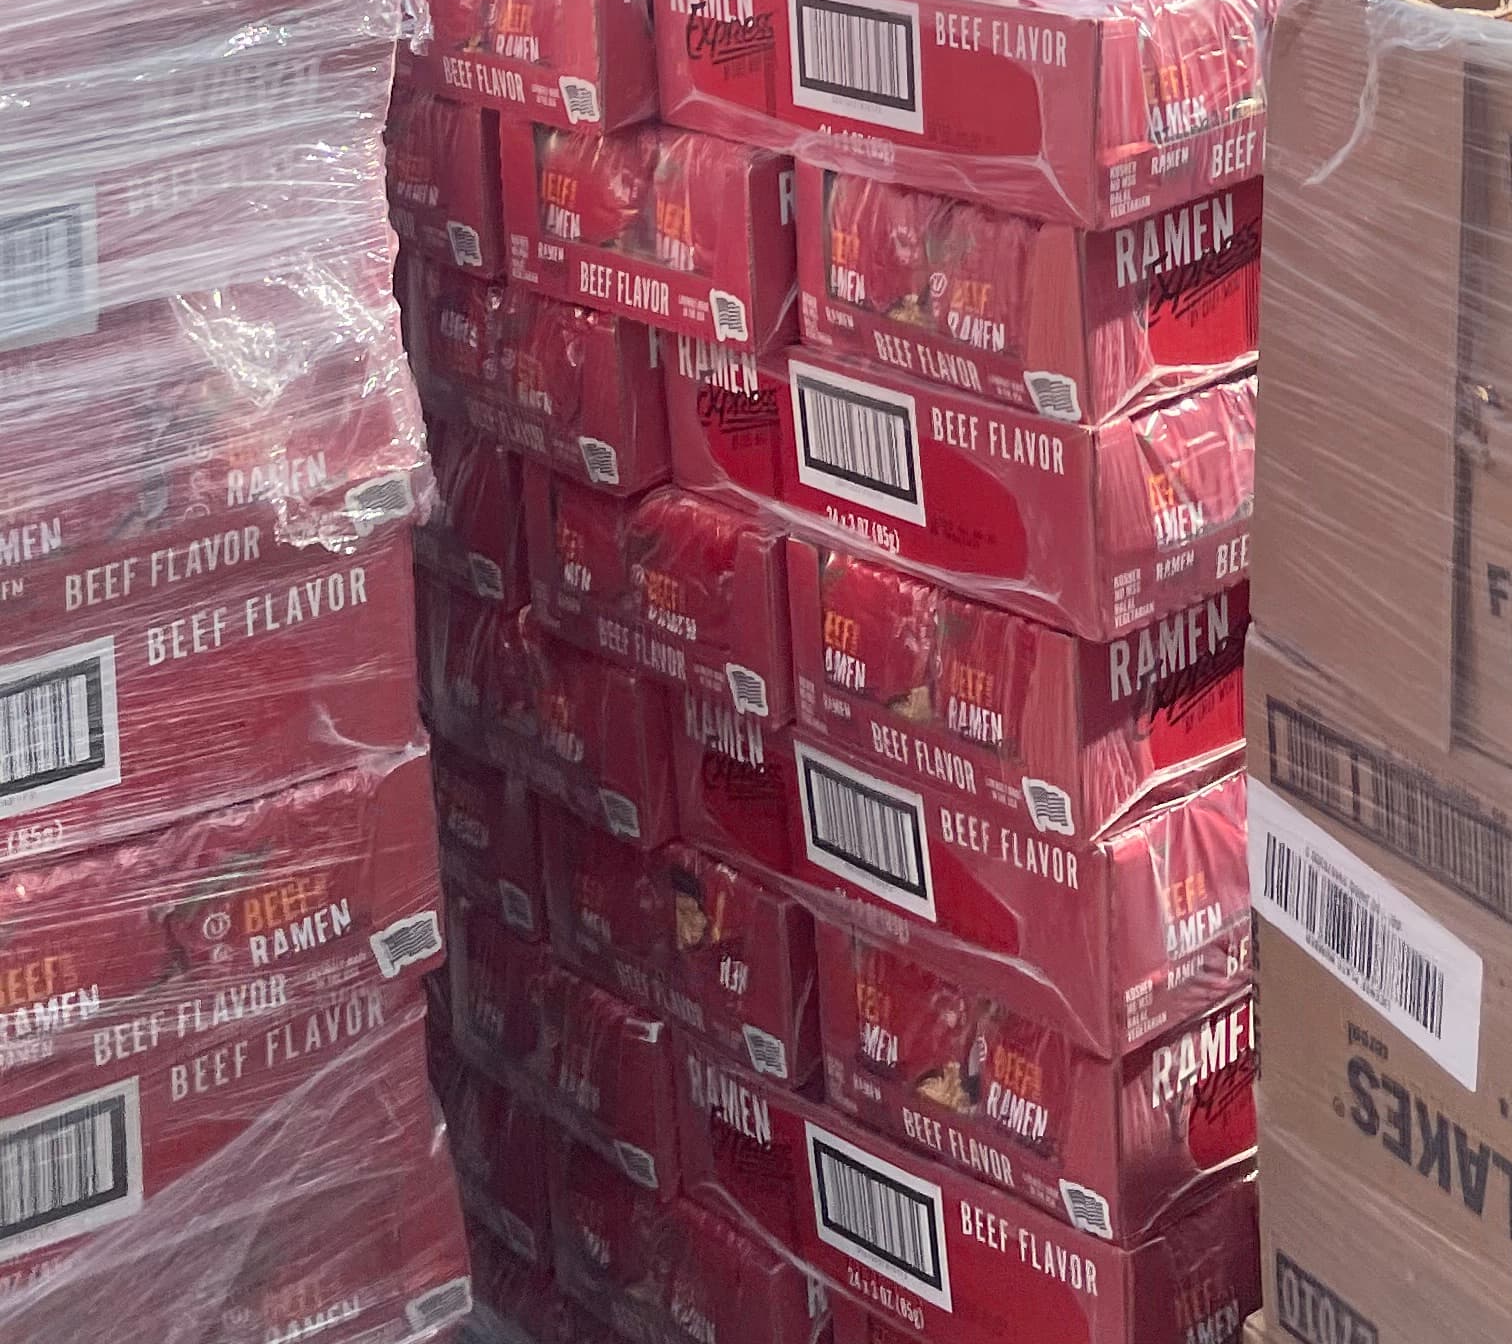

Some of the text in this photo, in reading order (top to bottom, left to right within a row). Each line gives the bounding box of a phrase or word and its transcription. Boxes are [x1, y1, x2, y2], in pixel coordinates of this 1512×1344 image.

[496, 33, 540, 62] RAMEN
[687, 1, 775, 62] Express
[935, 12, 1068, 67] BEEF FLAVOR
[443, 56, 526, 104] BEEF FLAVOR
[1151, 95, 1207, 141] AMEN
[1151, 146, 1189, 176] RAMEN
[1212, 130, 1256, 179] BEEF
[1115, 194, 1235, 289] RAMEN
[580, 260, 671, 317] BEEF FLAVOR
[831, 265, 866, 305] AMEN
[677, 333, 759, 401] RAMEN
[874, 330, 982, 392] BEEF FLAVOR
[931, 407, 1065, 476] BEEF FLAVOR
[872, 521, 900, 554] (85g)
[1155, 500, 1204, 545] AMEN
[65, 524, 261, 612] BEEF FLAVOR
[1156, 550, 1195, 582] RAMEN
[1216, 533, 1250, 580] BEE
[147, 566, 367, 666] BEEF FLAVOR
[635, 630, 686, 681] FLAVOR
[824, 646, 866, 691] AMEN
[1109, 594, 1229, 702] RAMEN
[950, 696, 1003, 747] RAMEN
[871, 720, 977, 794] BEEF FLAVOR
[941, 807, 1079, 890] BEEF FLAVOR
[250, 897, 352, 968] RAMEN
[1166, 902, 1222, 954] AMEN
[1167, 954, 1205, 991] RAMEN
[93, 974, 288, 1068] BEEF FLAVOR
[171, 988, 386, 1103] BEEF FLAVOR
[688, 1055, 772, 1151] RAMEN
[987, 1081, 1049, 1143] RAMEN
[903, 1107, 1014, 1186] BEEF FLAVOR
[960, 1200, 1098, 1297] BEEF FLAVOR
[896, 1292, 925, 1330] (85g)
